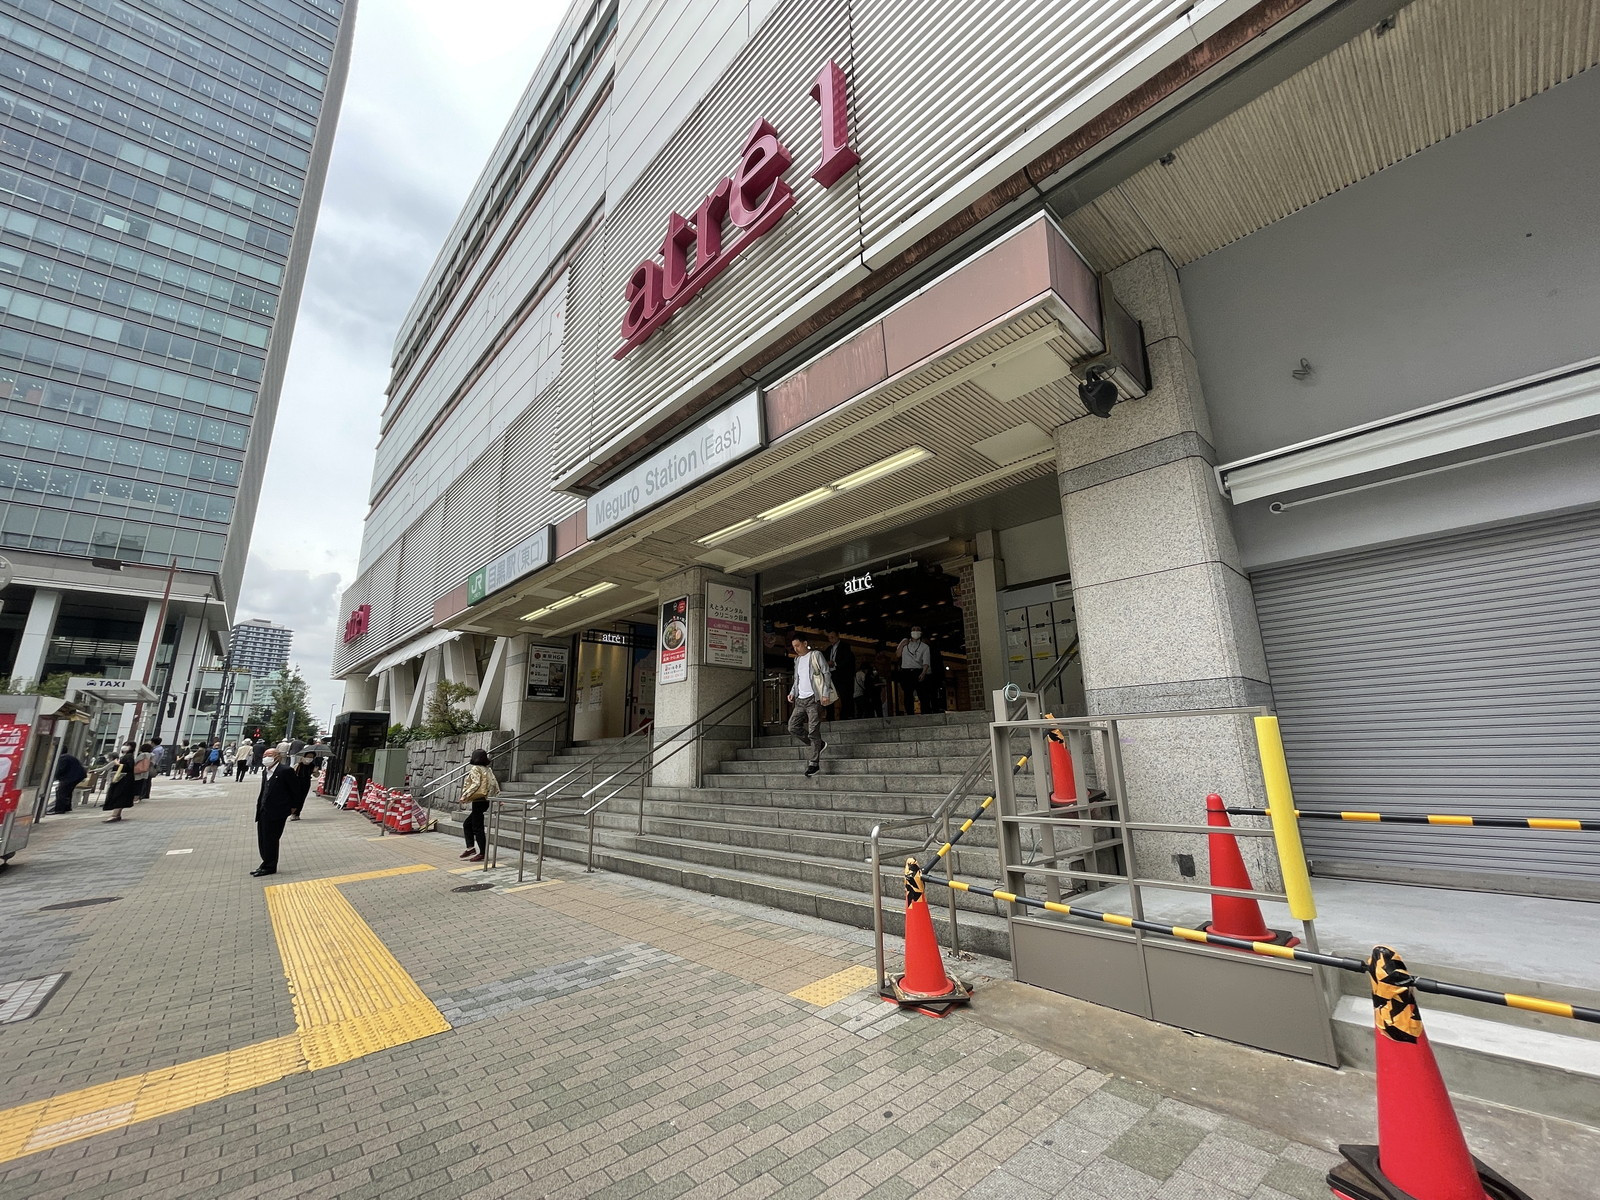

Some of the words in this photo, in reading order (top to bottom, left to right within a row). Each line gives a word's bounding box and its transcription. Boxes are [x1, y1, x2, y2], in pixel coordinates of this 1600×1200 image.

[619, 116, 795, 345] atré
[595, 485, 640, 526] Meguro
[488, 536, 544, 592] 目黒駅(東口)
[471, 573, 483, 594] JR
[844, 571, 873, 595] atré
[709, 603, 744, 614] えとうメンタル
[602, 632, 621, 644] atré
[99, 680, 126, 688] TAXI
